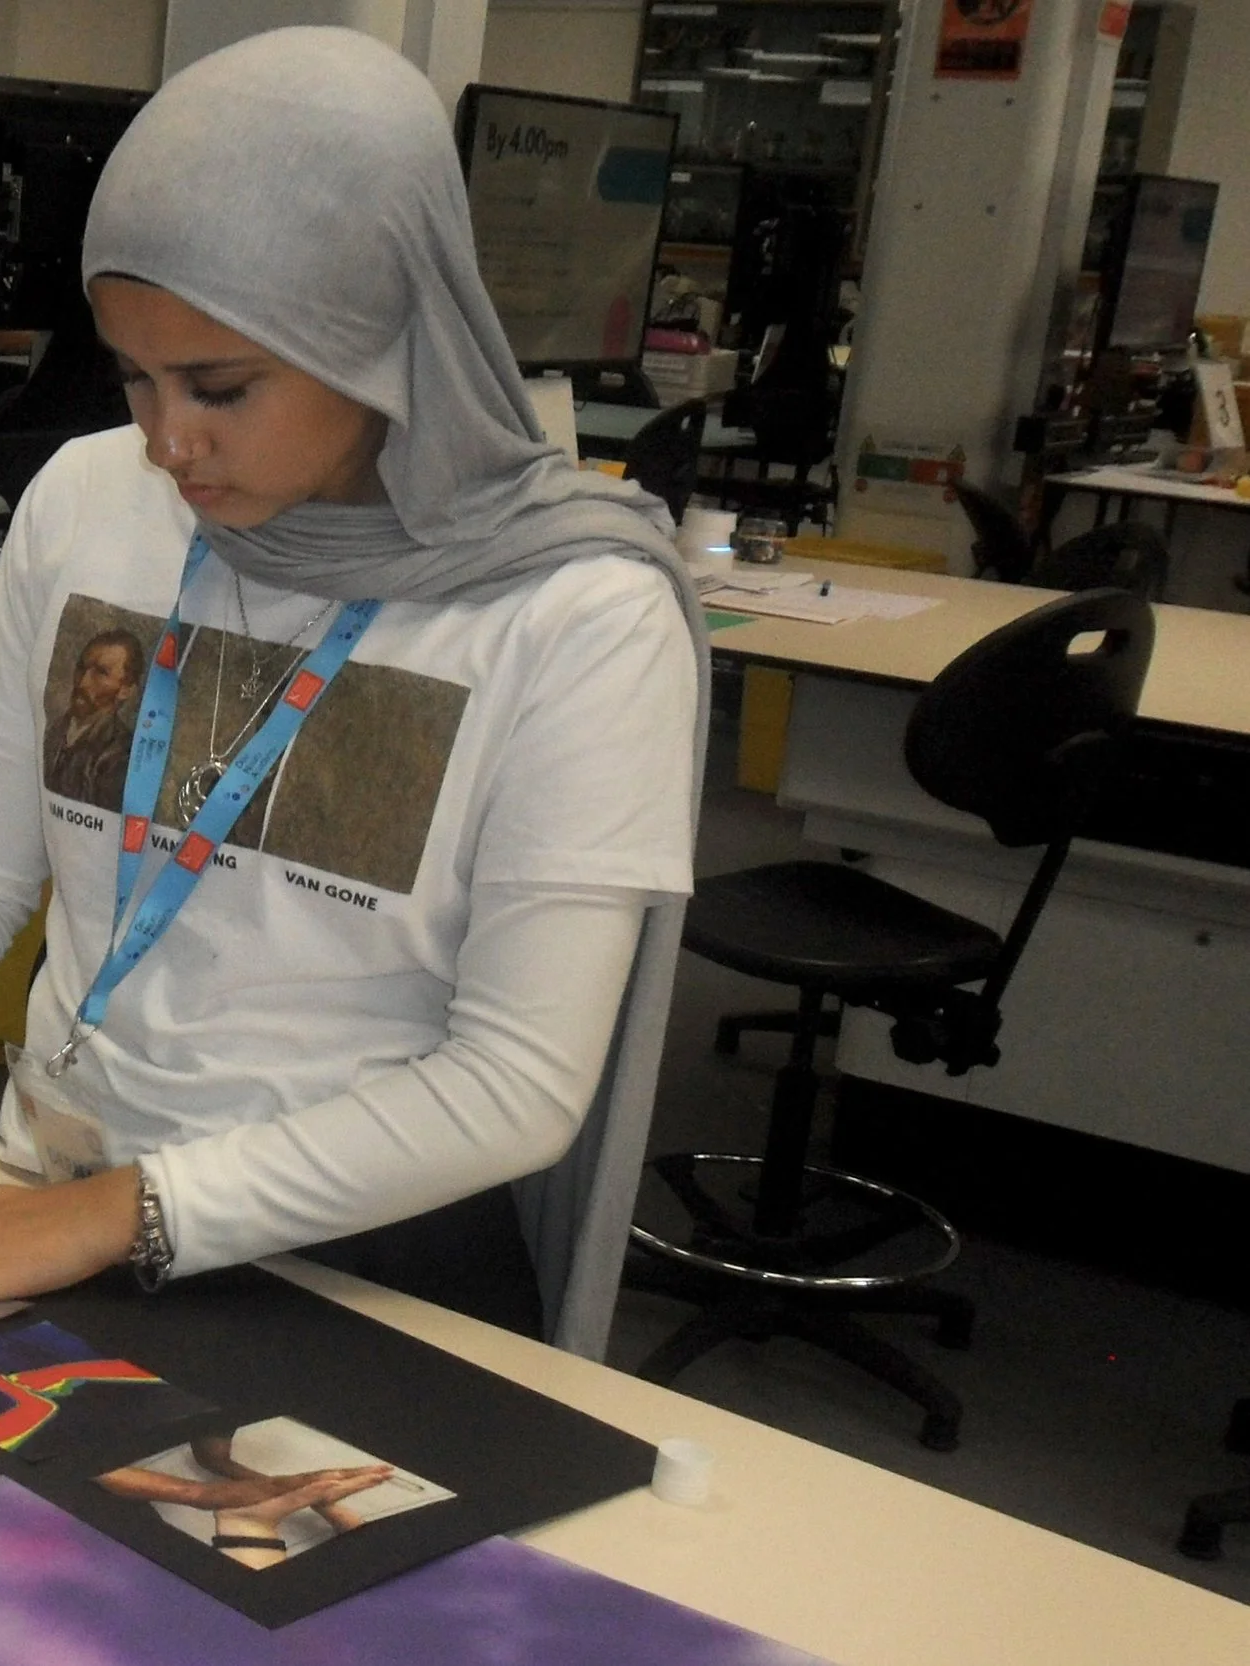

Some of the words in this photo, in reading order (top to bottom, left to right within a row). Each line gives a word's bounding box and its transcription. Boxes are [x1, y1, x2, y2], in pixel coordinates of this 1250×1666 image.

[487, 122, 507, 160] By
[509, 125, 569, 165] 4.00pm
[66, 809, 103, 832] GOGH
[151, 834, 179, 853] VAN
[285, 870, 320, 892] VAN
[325, 885, 378, 911] GONE
